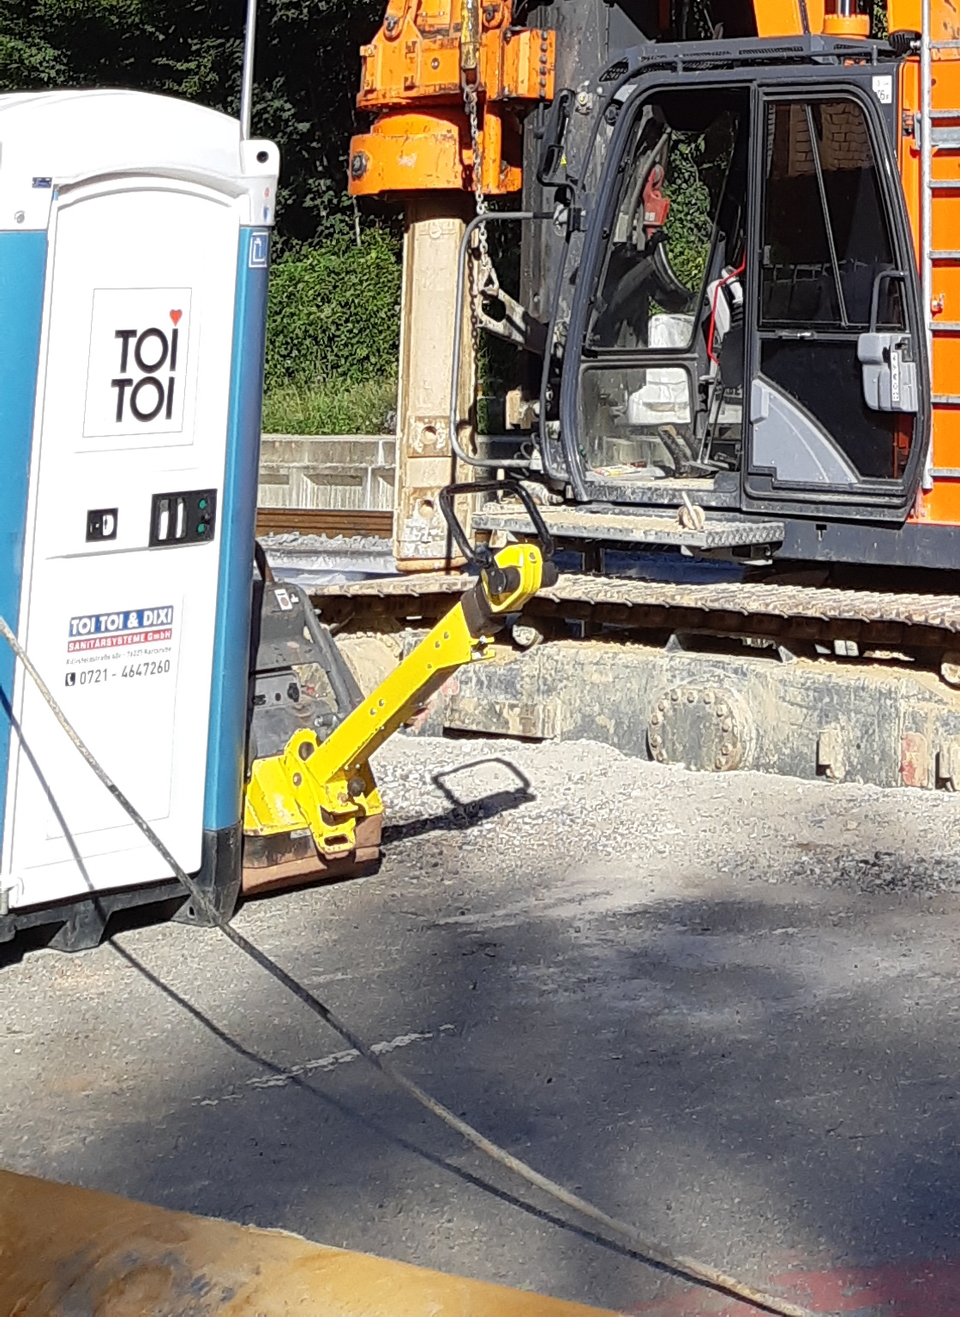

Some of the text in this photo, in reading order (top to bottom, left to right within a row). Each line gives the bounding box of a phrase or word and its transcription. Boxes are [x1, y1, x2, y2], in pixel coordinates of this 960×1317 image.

[111, 376, 175, 422] TOI
[70, 607, 172, 636] TOI TOI & DIXI
[79, 668, 108, 685] 0721
[121, 659, 171, 678] 4647260
